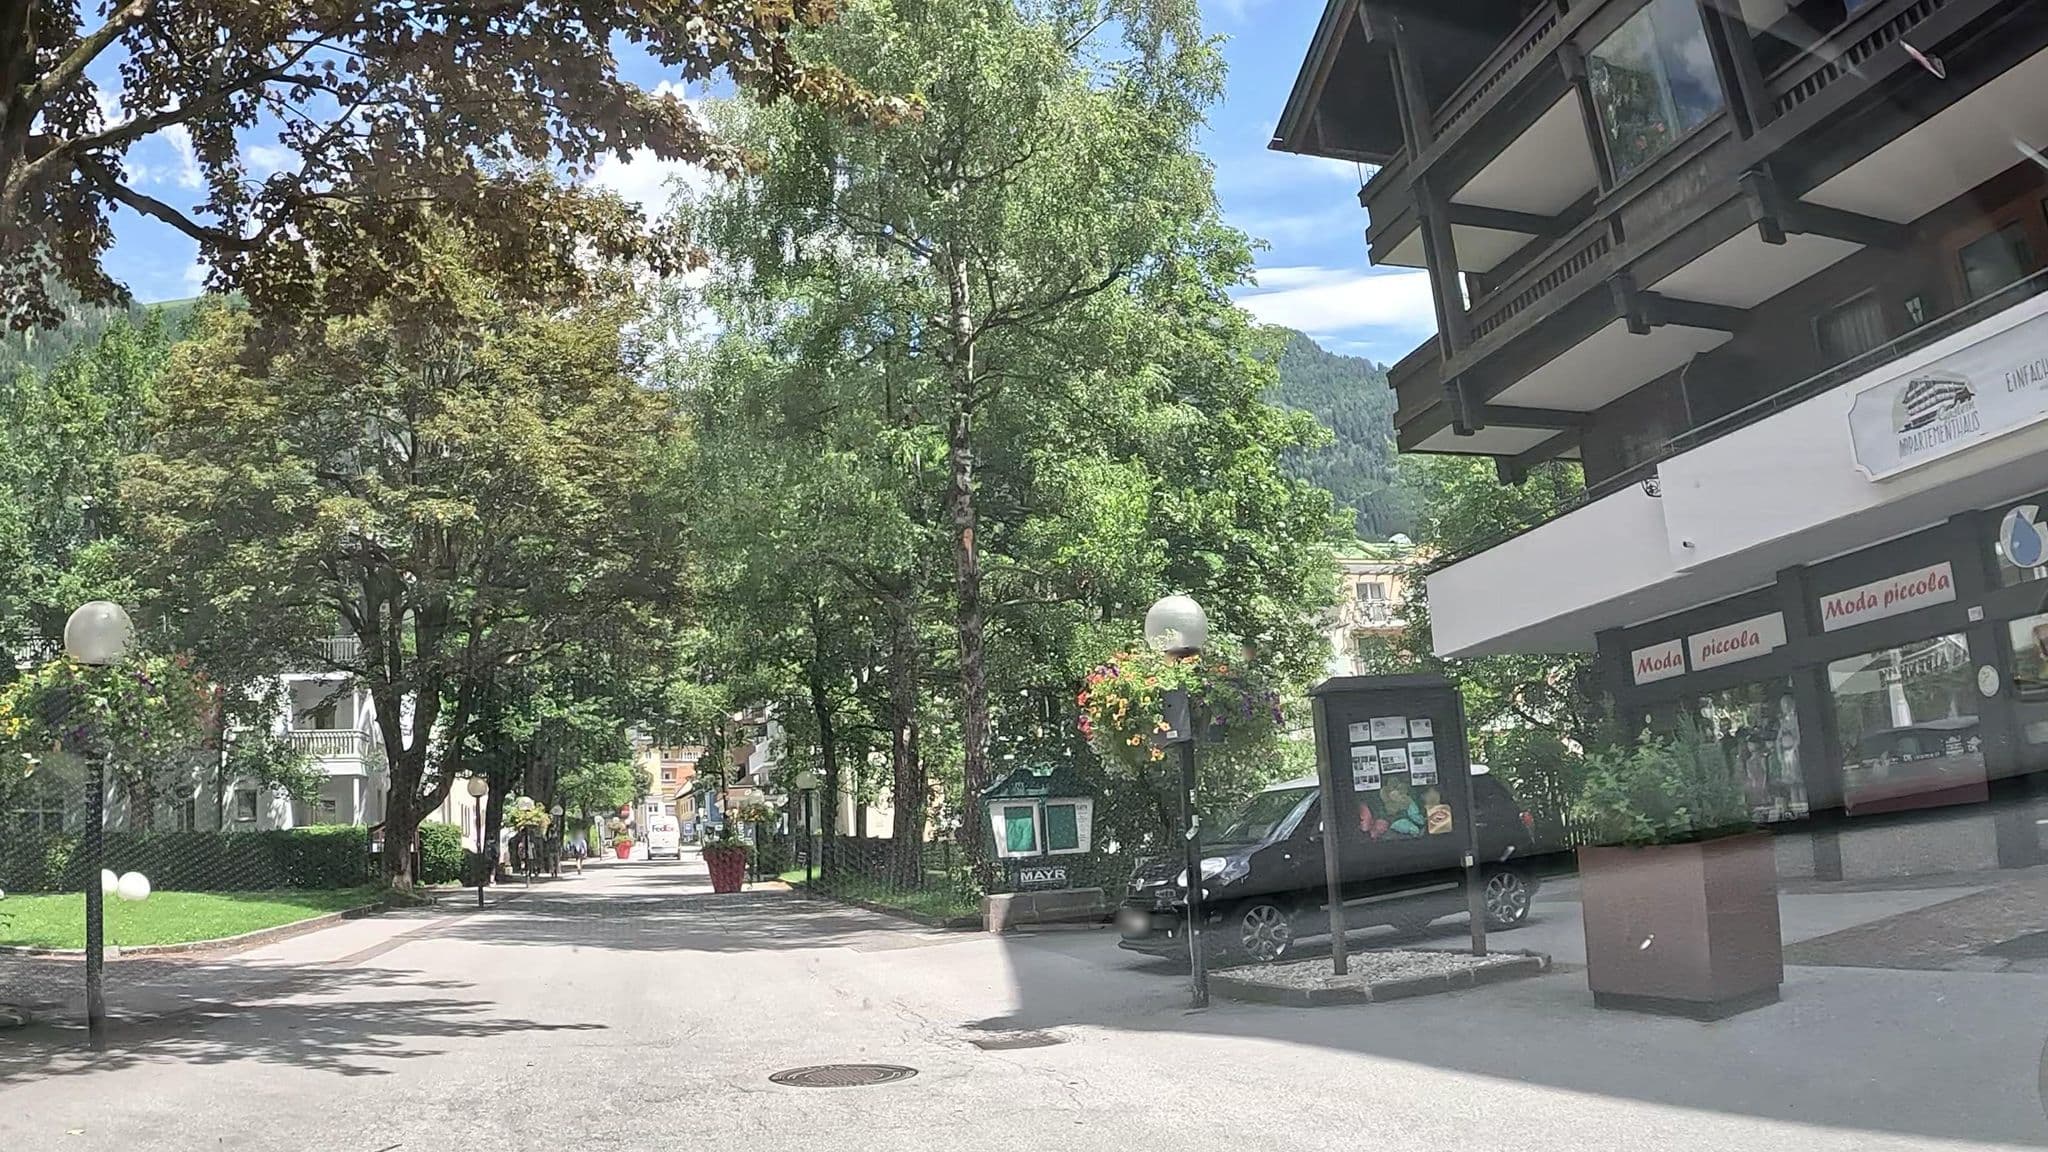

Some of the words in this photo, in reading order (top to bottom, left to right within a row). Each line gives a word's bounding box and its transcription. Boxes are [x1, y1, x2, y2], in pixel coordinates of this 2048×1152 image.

[1825, 591, 1878, 620] Moda
[1884, 572, 1950, 608] piccola
[1636, 651, 1683, 676] Moda
[1702, 631, 1760, 661] piccola
[1020, 869, 1066, 881] MAYR
